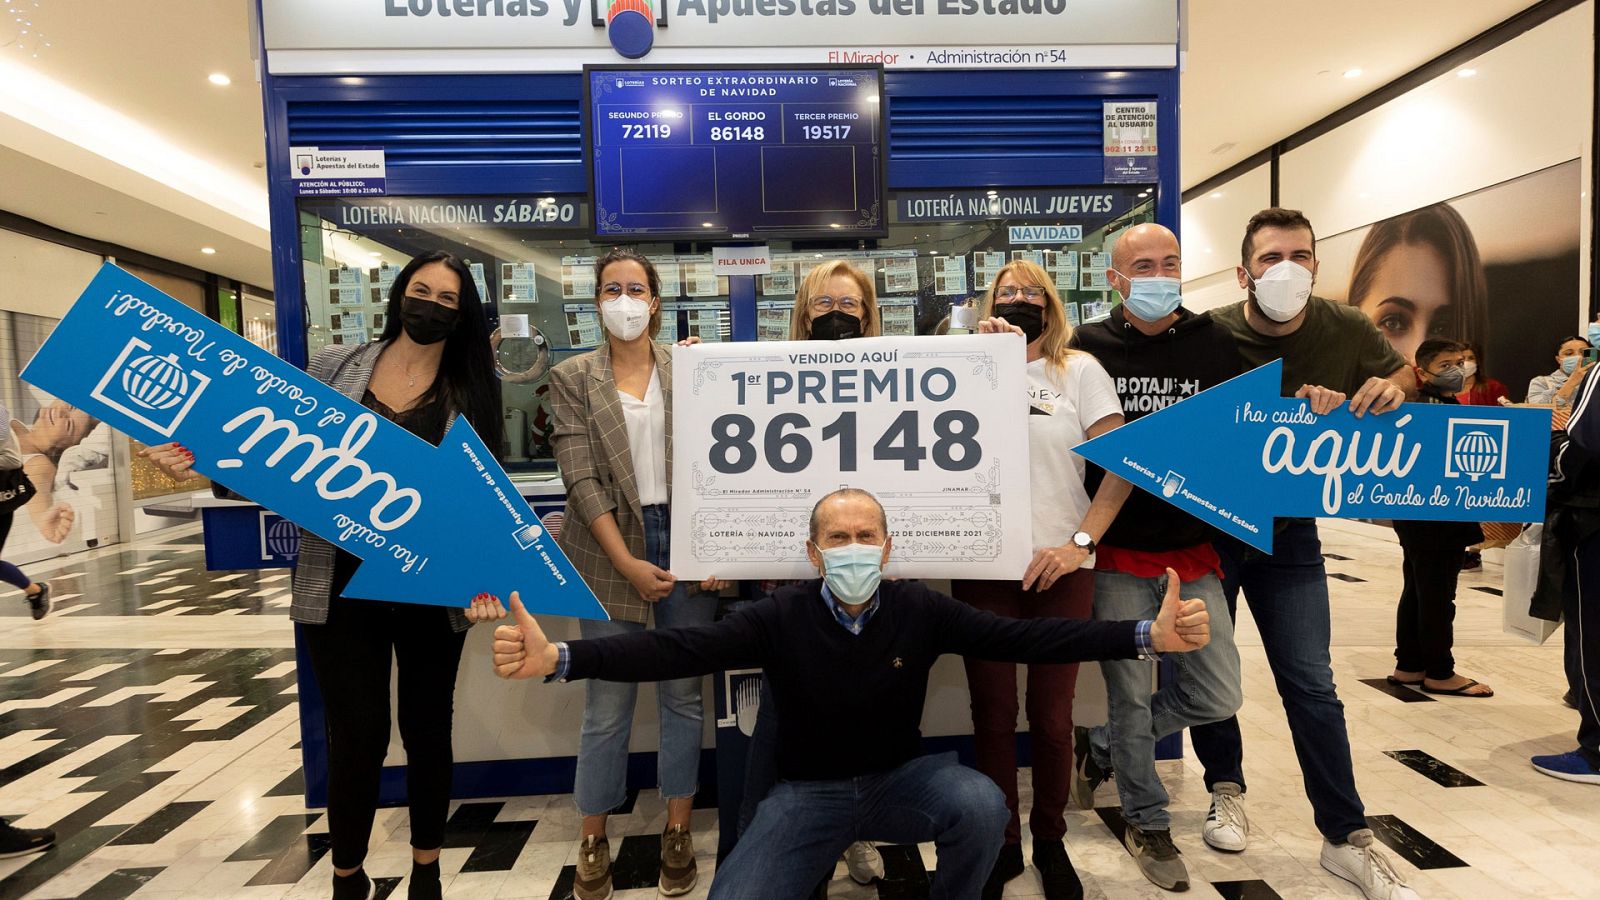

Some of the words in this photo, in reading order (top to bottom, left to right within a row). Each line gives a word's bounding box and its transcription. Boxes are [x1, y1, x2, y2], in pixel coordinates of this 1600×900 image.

[843, 50, 899, 64] Mirador
[926, 49, 1030, 64] Administración
[652, 77, 701, 86] SORTEO
[707, 76, 819, 86] EXTRAORDINARIO
[700, 88, 716, 96] DE
[721, 88, 777, 96] NAVIDAD
[708, 112, 722, 120] EL
[724, 111, 766, 121] GORDO
[1117, 113, 1156, 121] ATENCIÓN
[621, 124, 672, 139] 72119
[710, 126, 765, 141] 86148
[802, 125, 852, 140] 19517
[342, 202, 404, 224] LOTERÍA
[409, 204, 487, 224] NACIONAL
[493, 200, 574, 223] SÁBADO
[907, 195, 965, 218] LOTERÍA
[968, 197, 1040, 216] NACIONAL
[1046, 194, 1113, 214] JUEVES
[1011, 226, 1080, 240] NAVIDAD
[740, 258, 766, 266] UNICA
[105, 290, 216, 362] Navidad!
[218, 348, 248, 376] de
[788, 352, 856, 364] VENDIDO
[860, 348, 898, 364] AQUÍ
[250, 366, 319, 416] Gordo
[766, 366, 957, 405] PREMIO
[317, 408, 345, 428] el
[708, 410, 983, 474] 86148
[461, 442, 485, 472] Estado
[1262, 414, 1422, 515] aquí
[216, 406, 422, 532] aquí
[482, 472, 496, 486] del
[494, 486, 524, 525] Apuestas
[1156, 476, 1162, 484] y
[1180, 488, 1217, 512] Apuestas
[1218, 508, 1232, 520] del
[1232, 515, 1259, 534] Estado
[1347, 483, 1364, 505] el
[1370, 484, 1426, 506] Gordo
[1429, 485, 1450, 507] de
[1454, 485, 1532, 510] Navidad!
[709, 530, 744, 538] LOTERÍA
